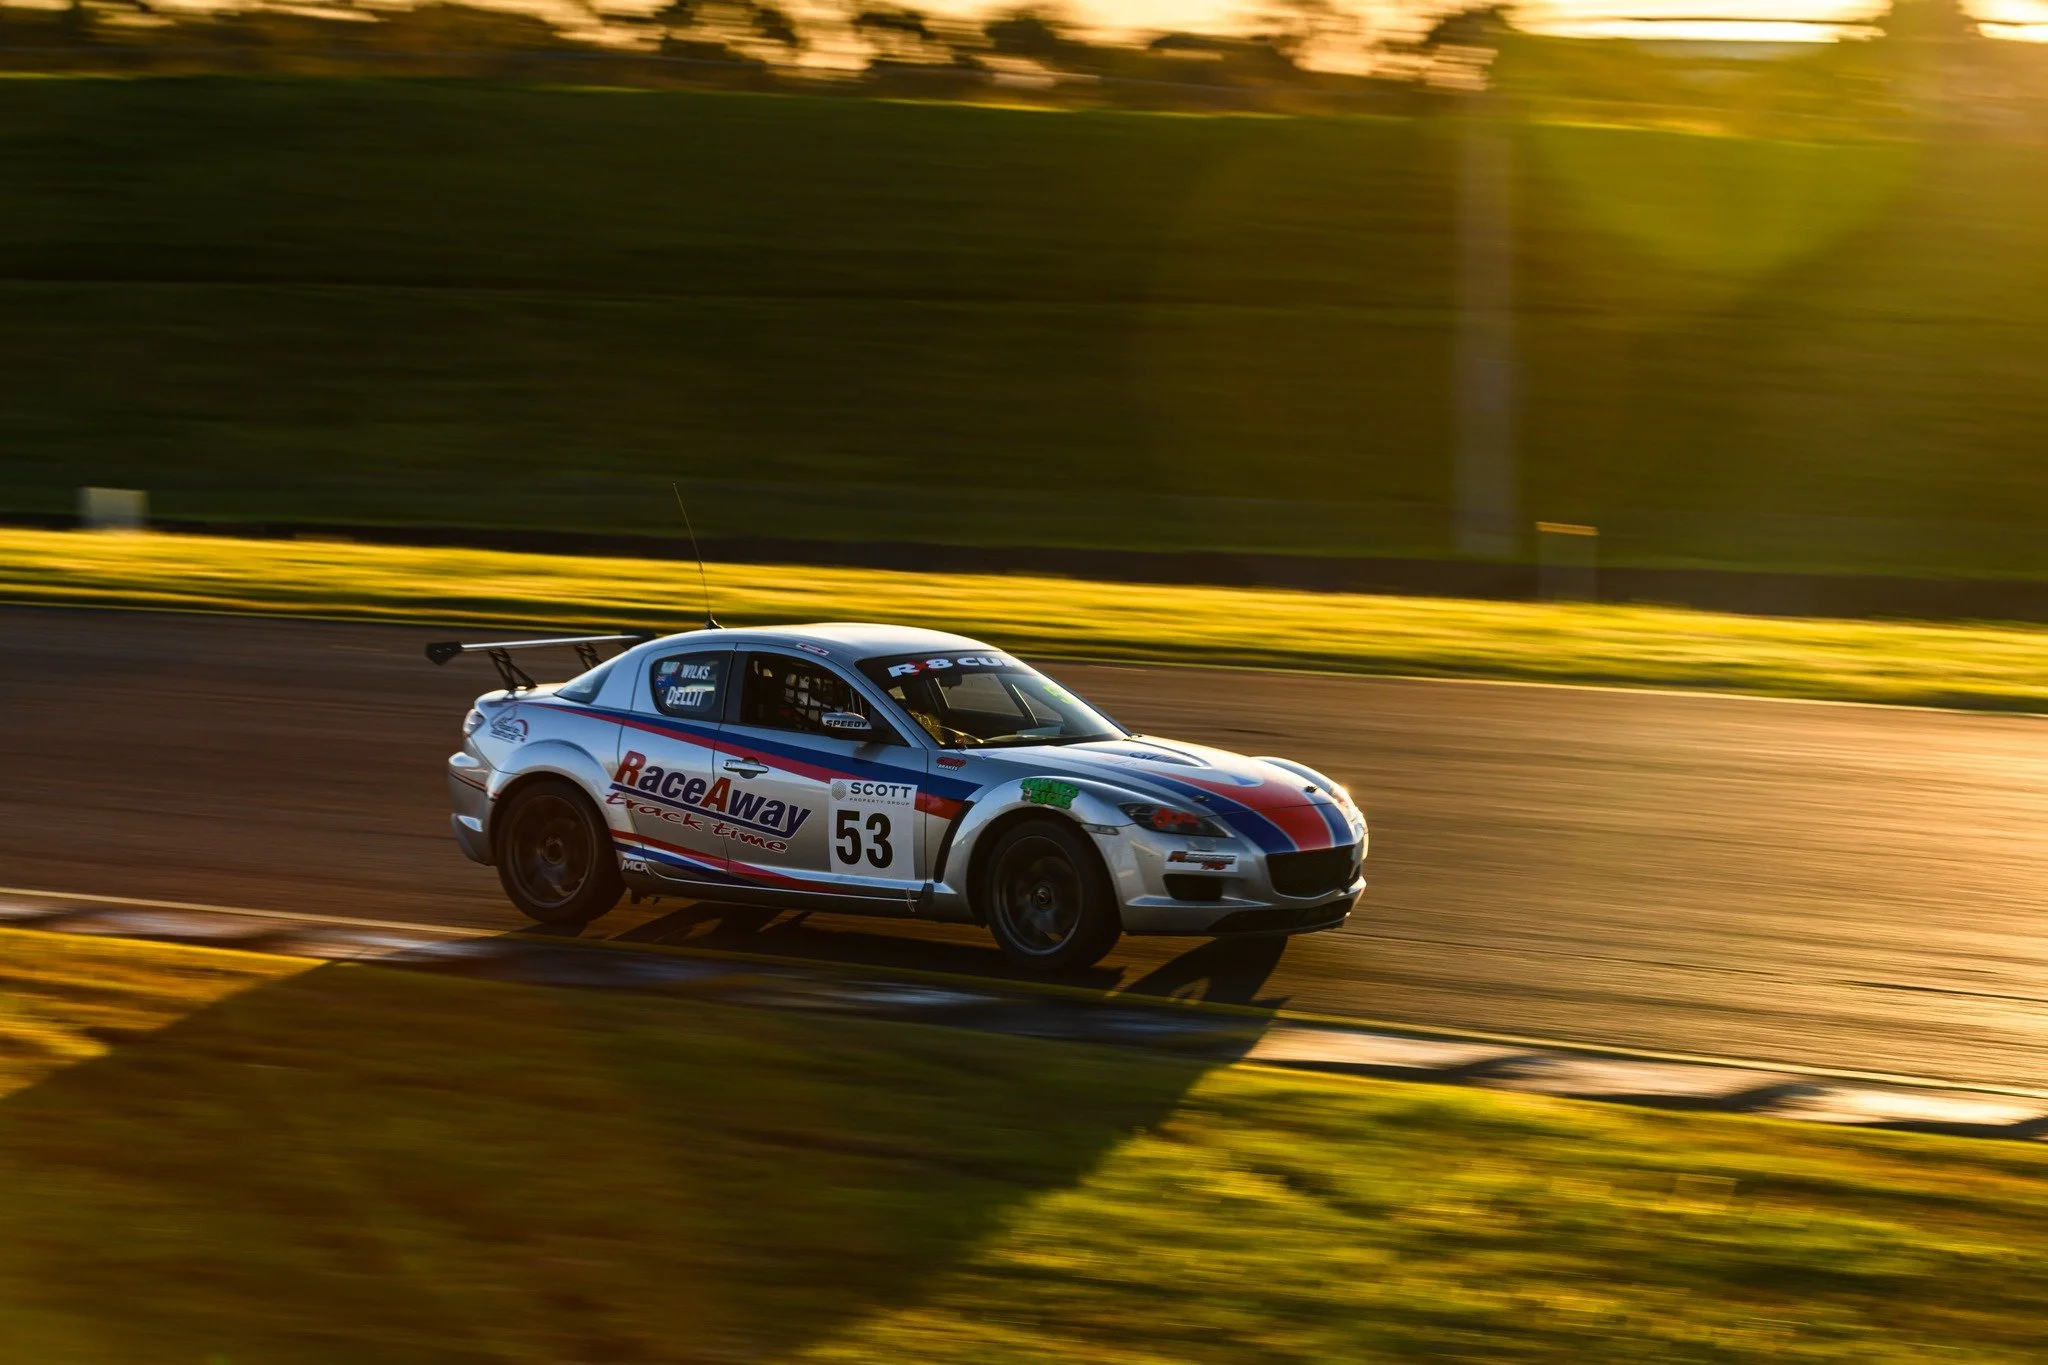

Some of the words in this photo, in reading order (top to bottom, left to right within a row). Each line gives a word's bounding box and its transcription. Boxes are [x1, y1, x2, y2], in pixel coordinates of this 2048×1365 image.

[681, 664, 710, 680] WILKS
[665, 685, 706, 706] DELLIT
[826, 720, 867, 729] SPEEDY
[612, 750, 812, 839] RaceAway
[850, 782, 912, 799] SCOTT
[605, 792, 704, 831] track
[712, 822, 788, 854] time
[836, 809, 893, 869] 53
[620, 859, 651, 876] MCA
